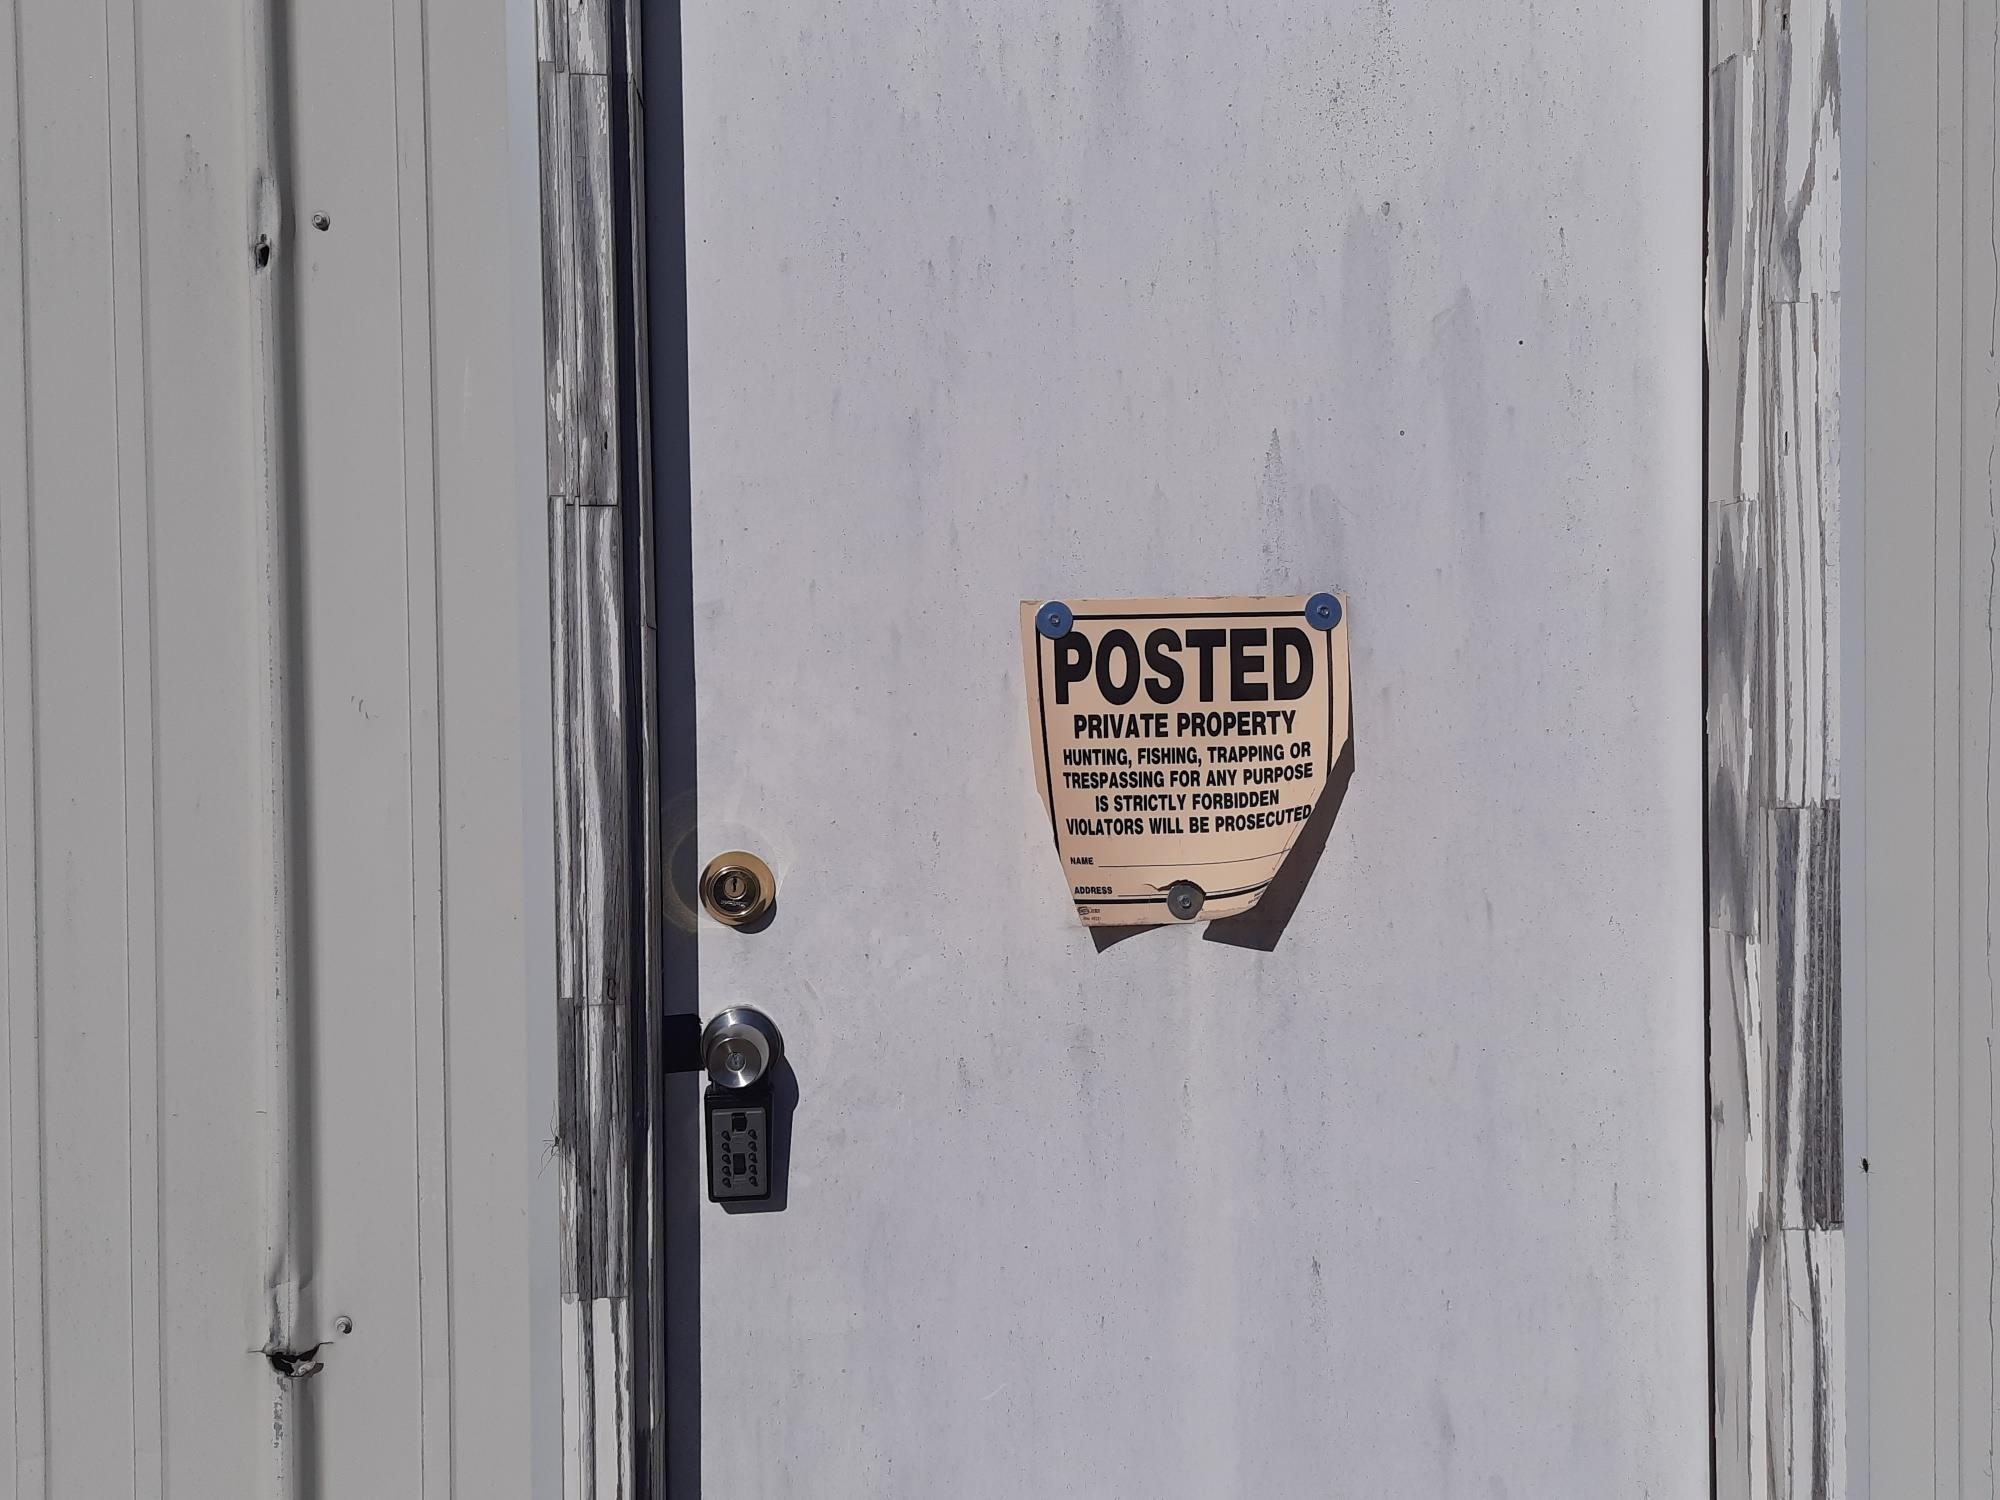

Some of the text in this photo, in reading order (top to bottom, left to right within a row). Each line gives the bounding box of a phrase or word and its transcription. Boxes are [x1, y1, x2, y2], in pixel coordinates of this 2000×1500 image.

[1054, 627, 1314, 705] POSTED
[1073, 709, 1297, 740] PRIVATE PROPERTY
[1062, 741, 1311, 769] HUNTING, FISHING, TRAPPING OR
[1062, 762, 1313, 790] TRESPASSING FOR ANY PURPOSE
[1095, 788, 1280, 813] IS STRICTLY FORBIDDEN
[1065, 804, 1312, 836] VIOLATORS WILL BE PROSECUTED
[1069, 856, 1094, 866] NAME
[1073, 885, 1113, 895] ADDRESS
